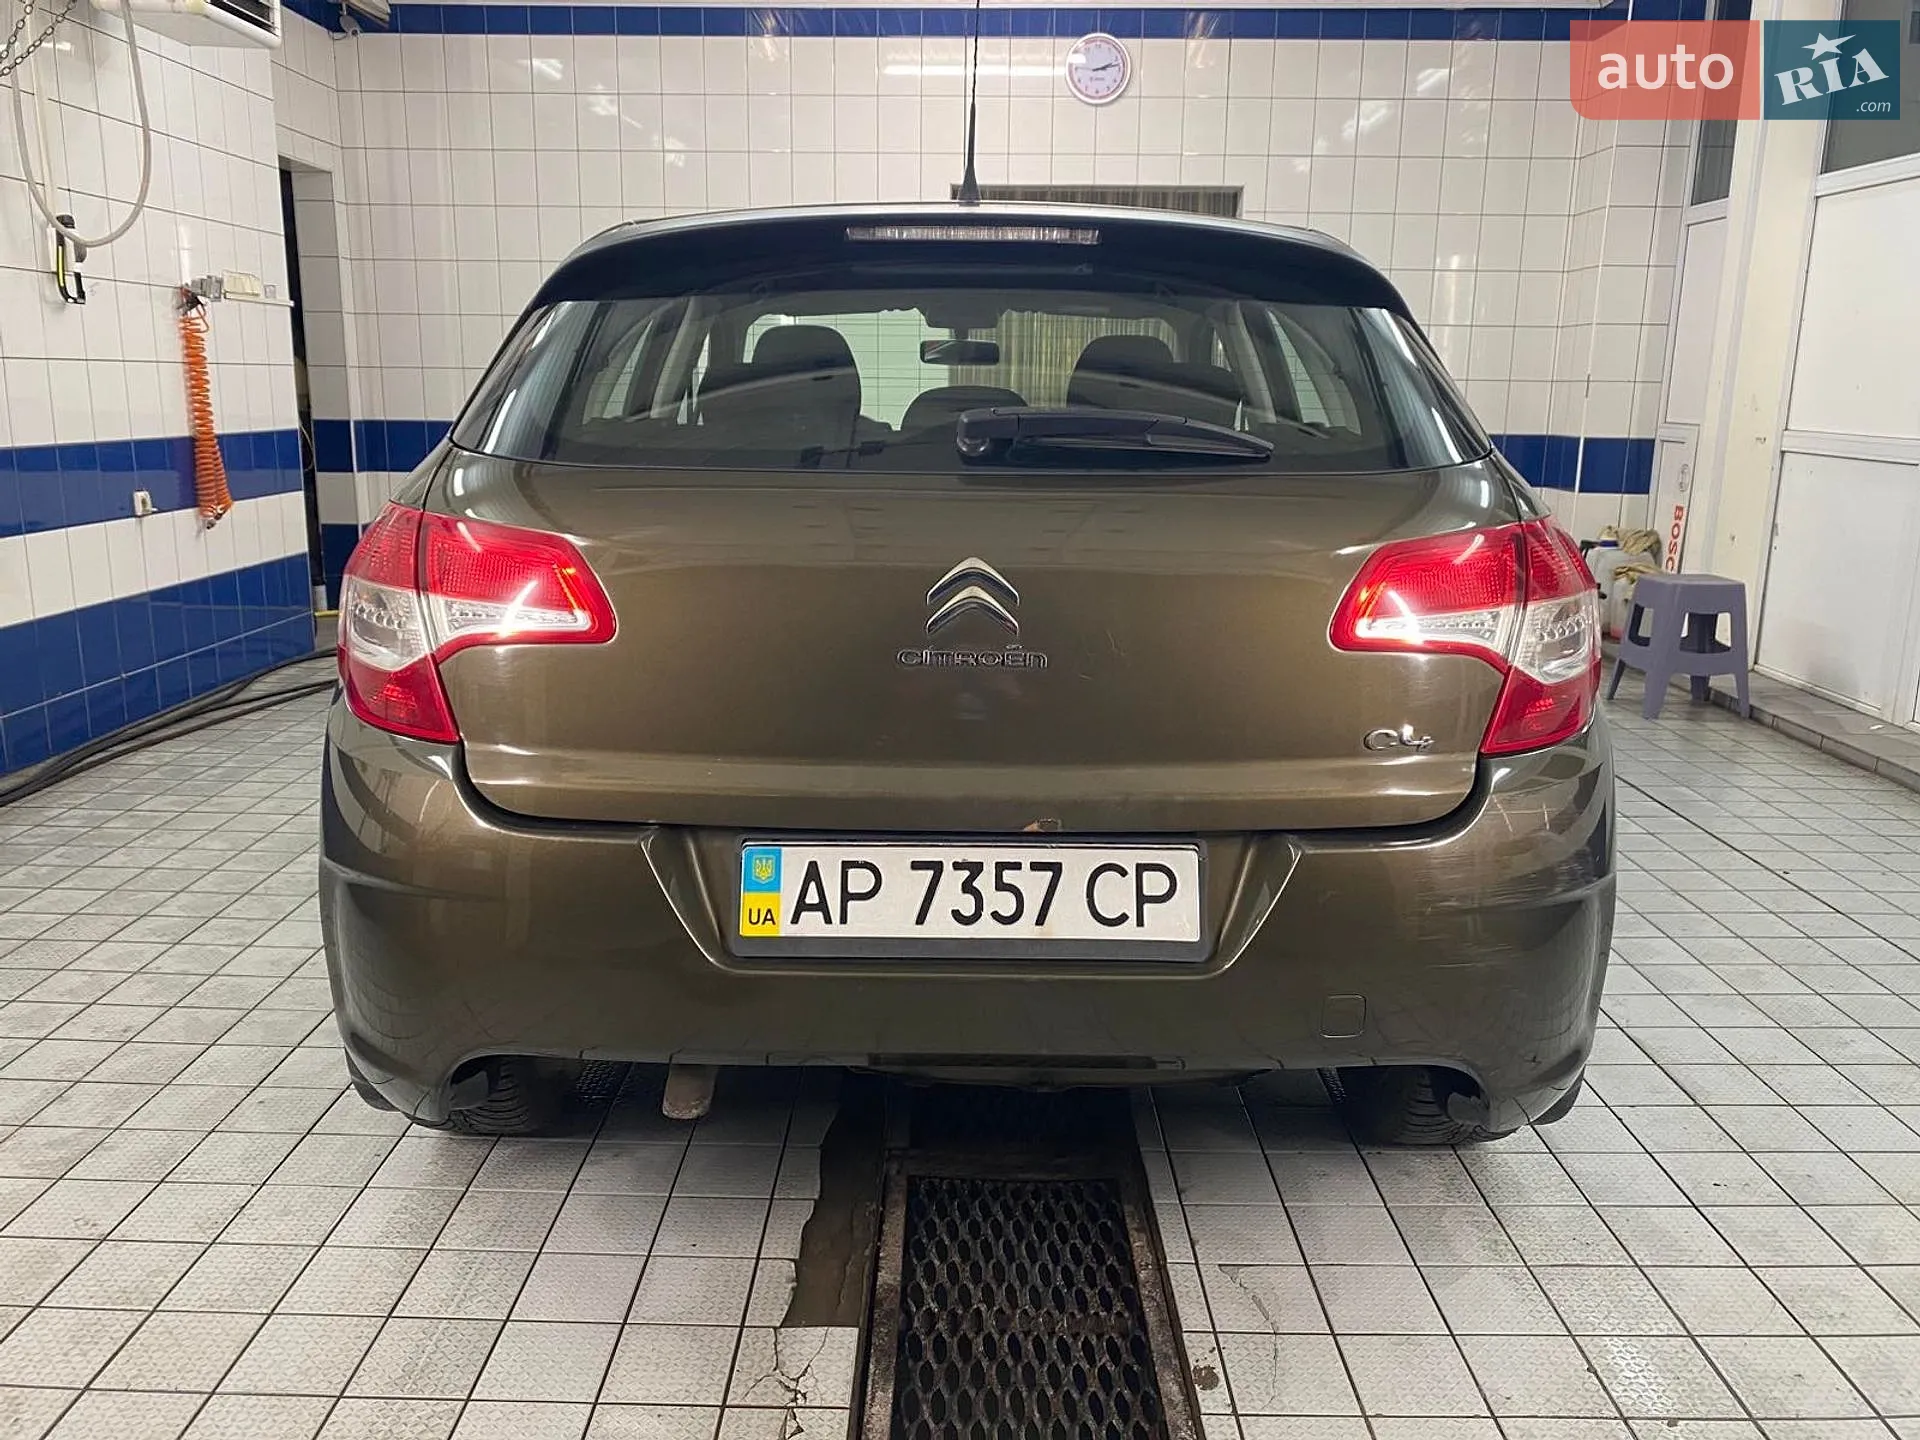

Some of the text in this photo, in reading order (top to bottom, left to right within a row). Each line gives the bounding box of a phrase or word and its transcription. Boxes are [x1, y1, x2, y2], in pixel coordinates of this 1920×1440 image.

[1666, 505, 1684, 573] BOSC
[1363, 723, 1434, 752] C4
[748, 908, 776, 926] UA
[790, 860, 1178, 928] AP 7357 CP
